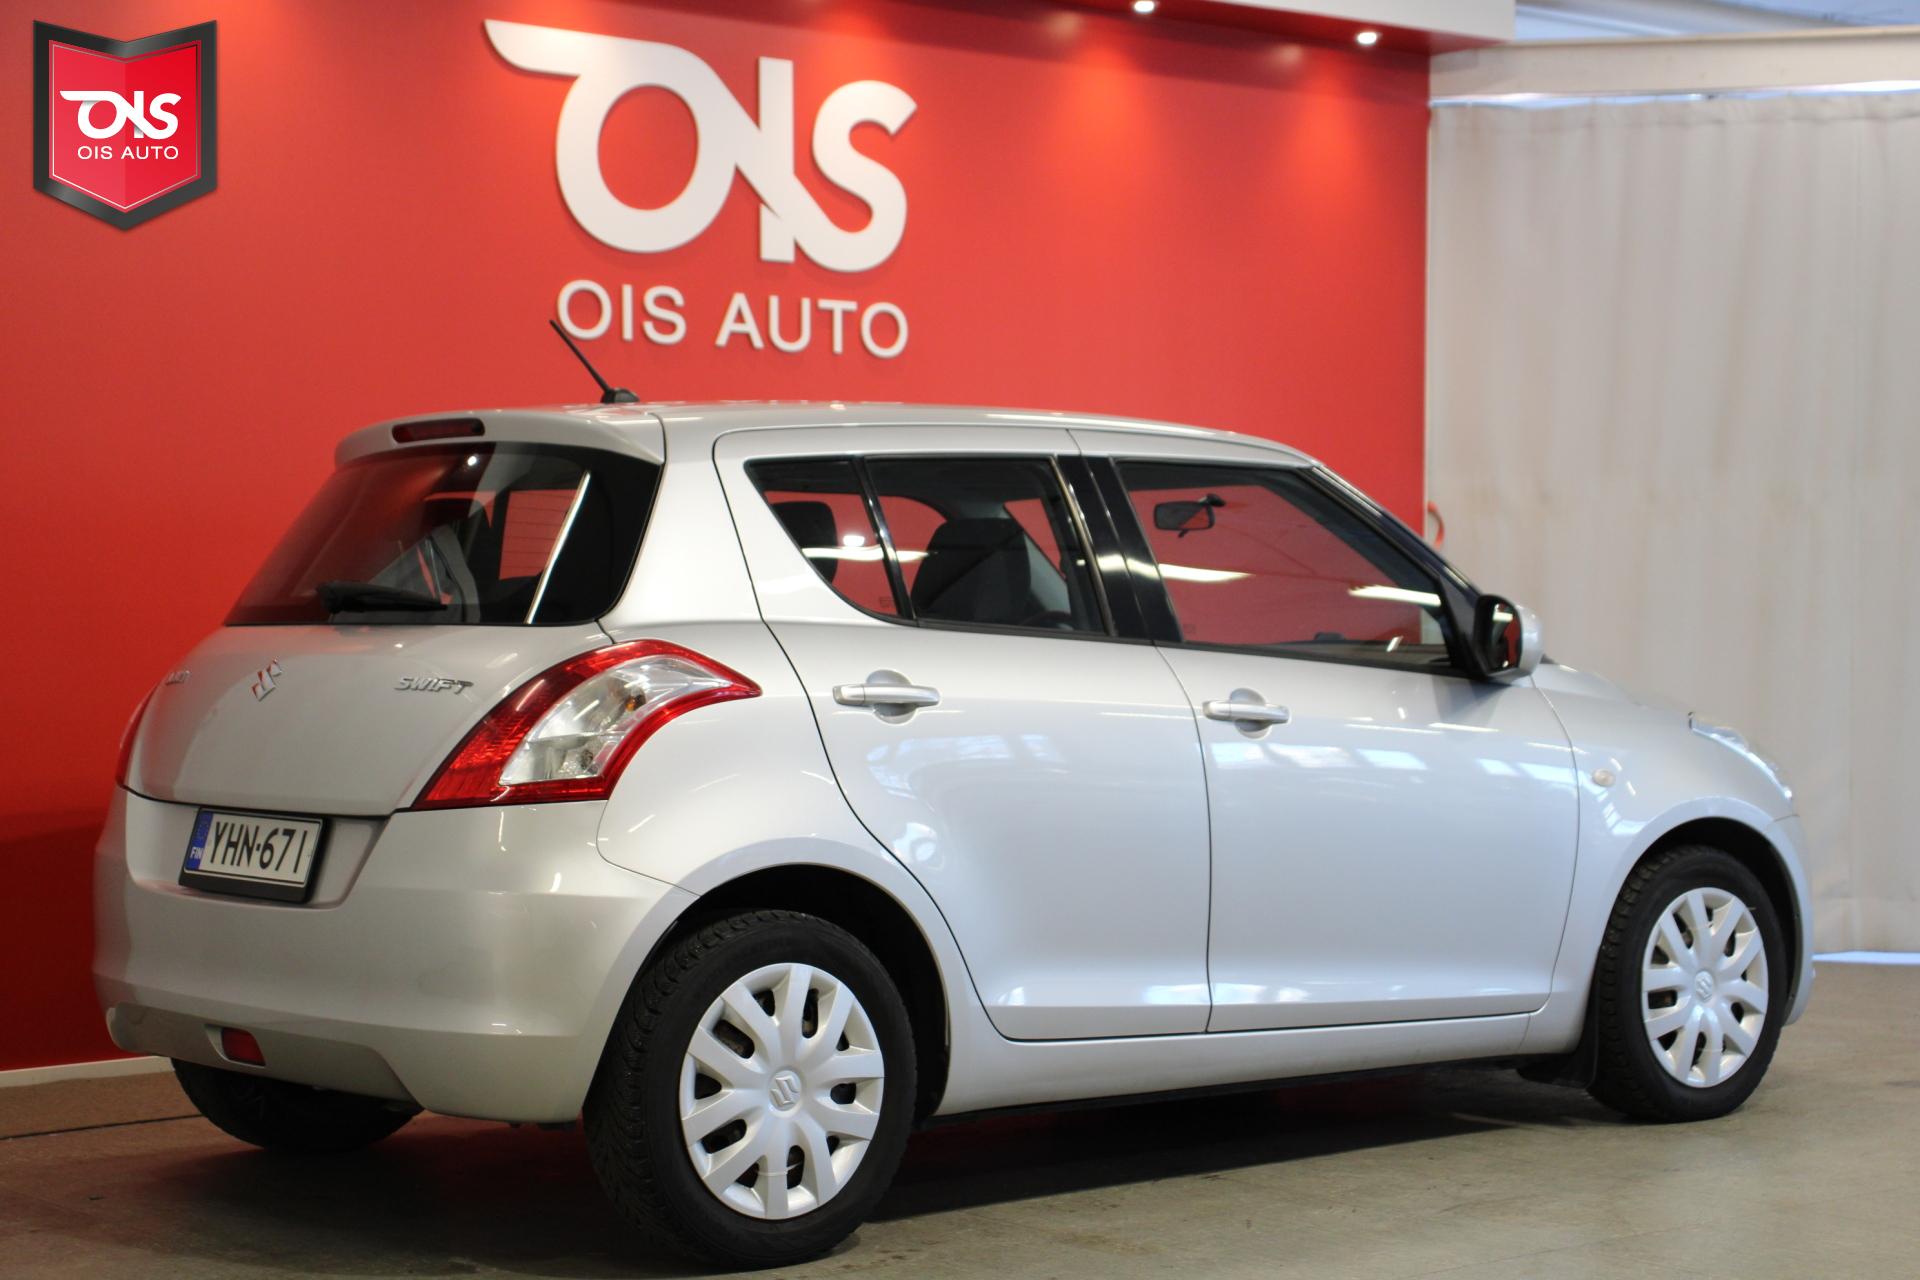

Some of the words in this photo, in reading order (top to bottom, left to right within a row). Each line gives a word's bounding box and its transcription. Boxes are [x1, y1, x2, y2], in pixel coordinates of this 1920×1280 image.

[484, 18, 918, 272] OIS
[557, 279, 687, 345] OIS
[715, 292, 909, 358] AUTO
[394, 677, 475, 695] SWIFT
[189, 846, 204, 860] FIN
[210, 821, 308, 874] YHN-671
